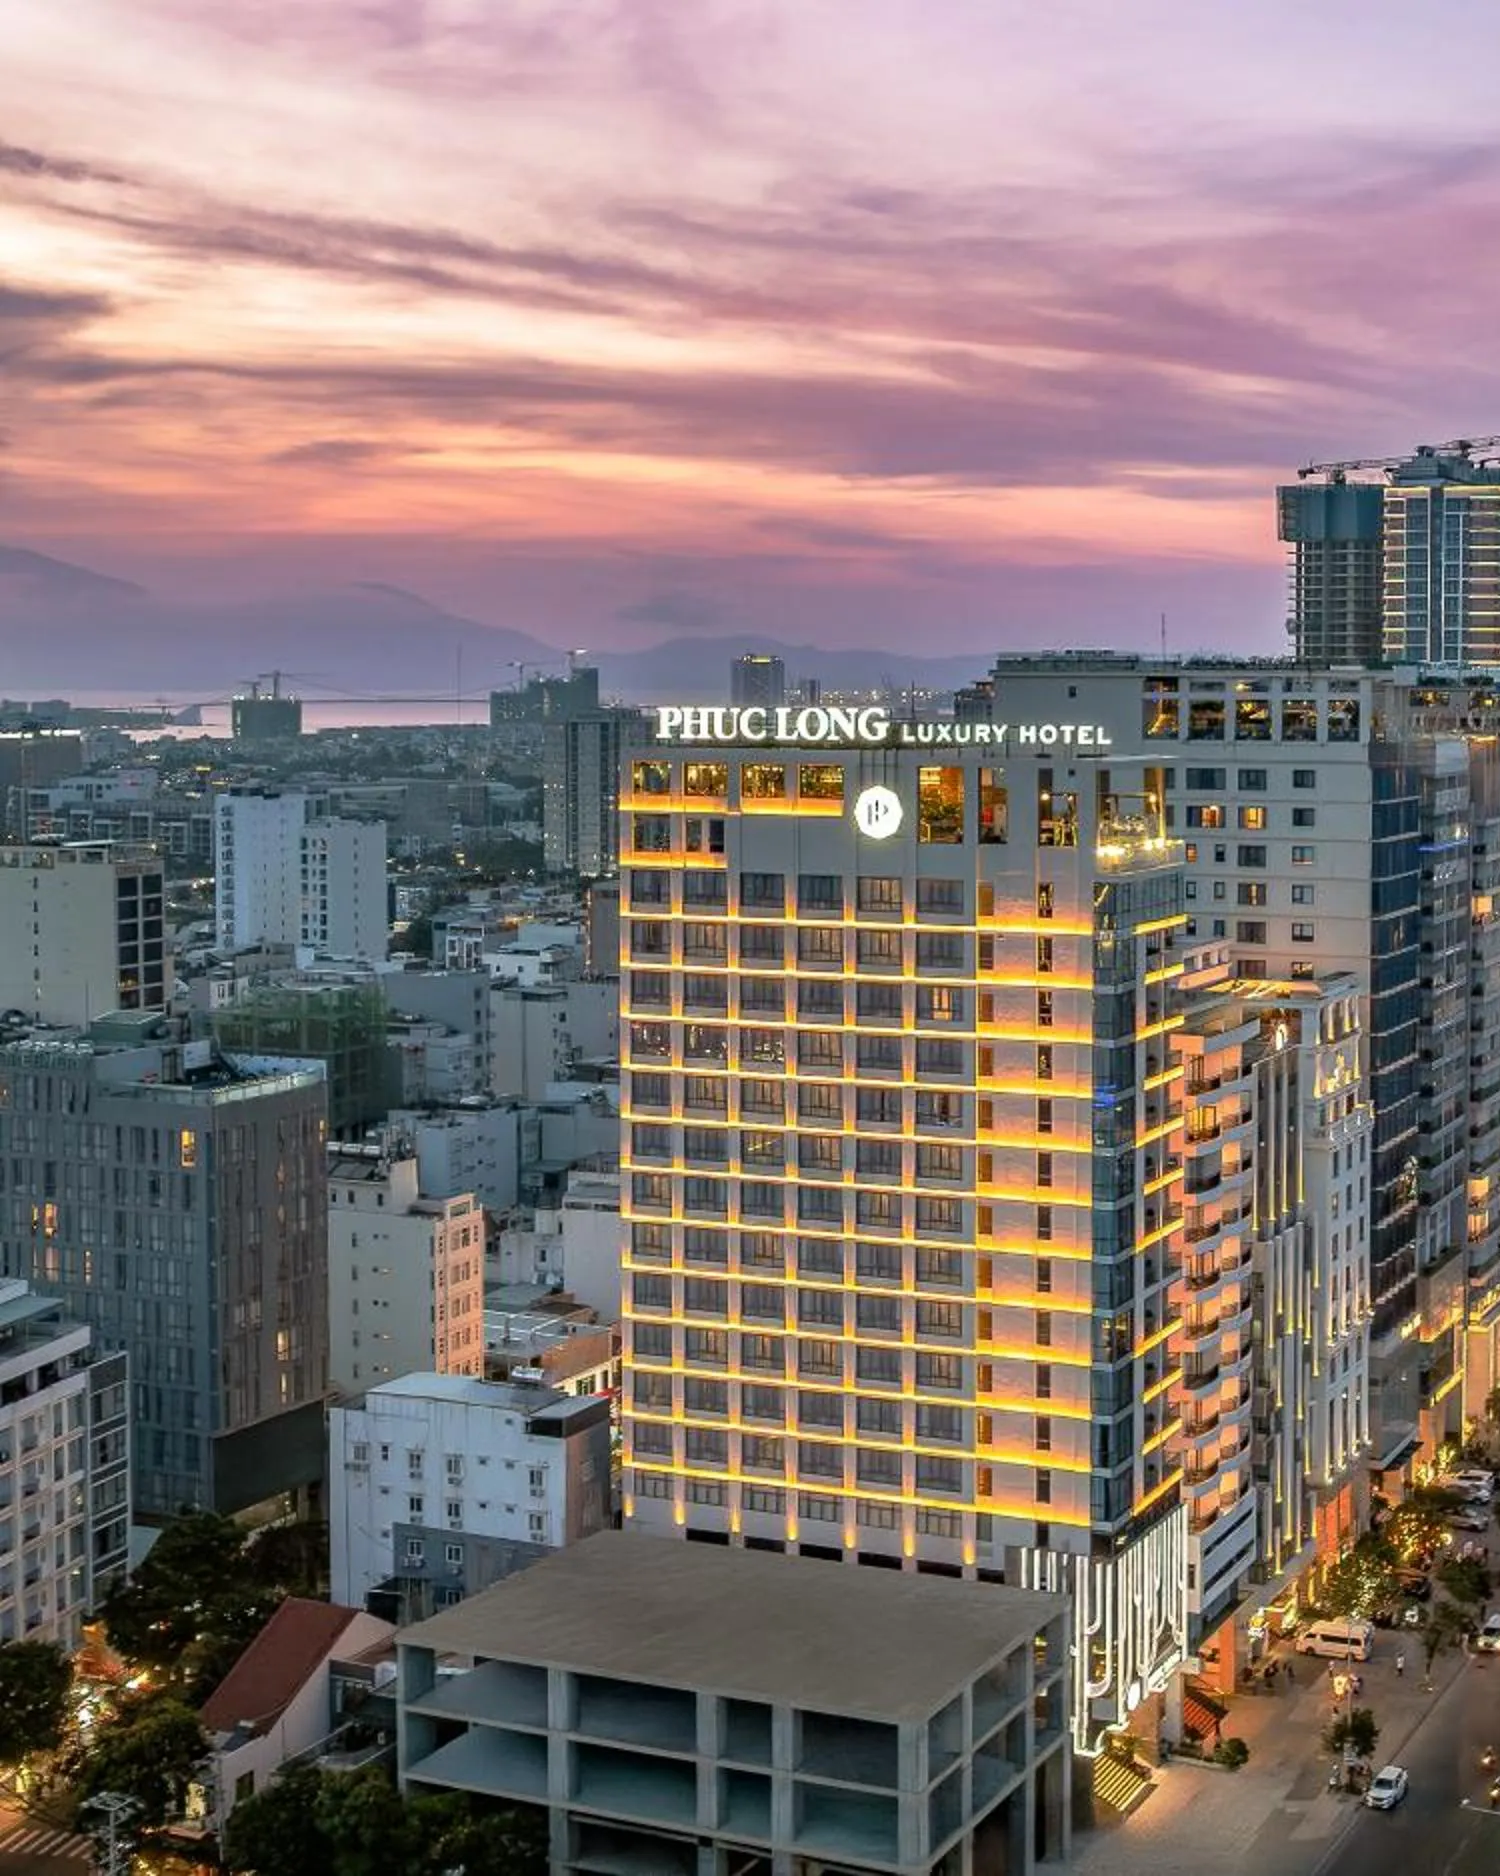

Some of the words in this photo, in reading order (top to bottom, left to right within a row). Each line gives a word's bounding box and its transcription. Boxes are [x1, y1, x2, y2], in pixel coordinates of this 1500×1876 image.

[656, 706, 767, 740] PHUC
[774, 706, 890, 741] LONG
[902, 724, 1008, 743] LUXURY
[1019, 725, 1112, 745] HOTEL
